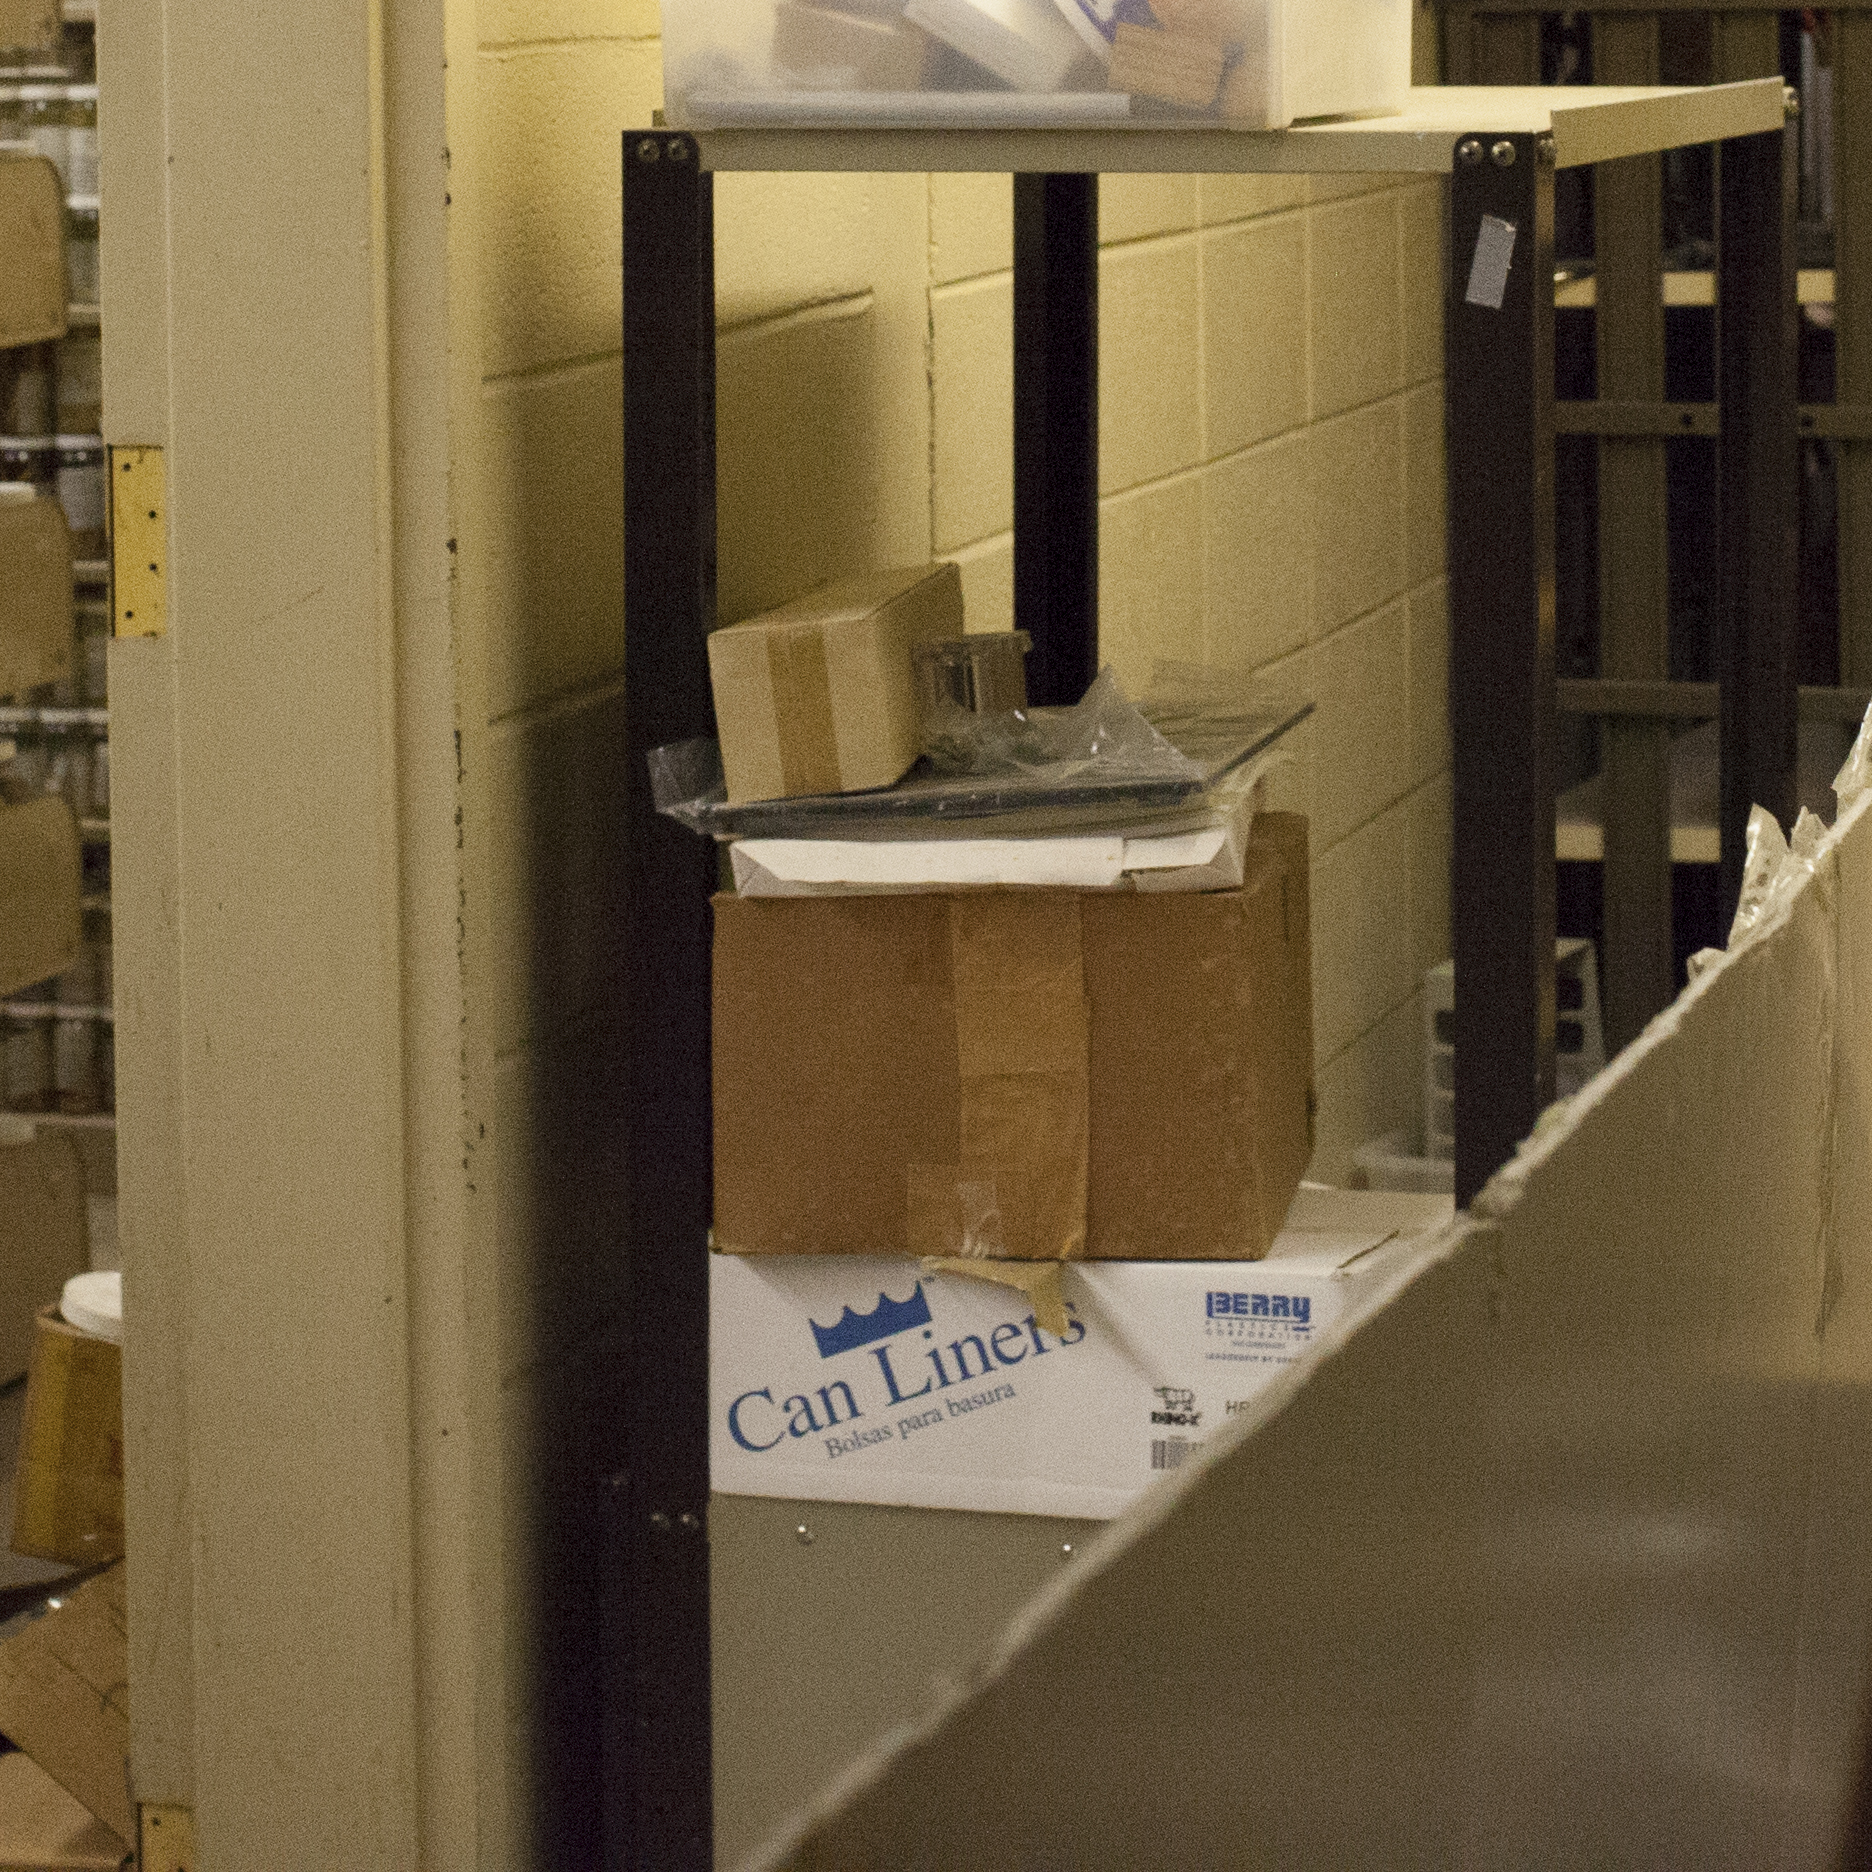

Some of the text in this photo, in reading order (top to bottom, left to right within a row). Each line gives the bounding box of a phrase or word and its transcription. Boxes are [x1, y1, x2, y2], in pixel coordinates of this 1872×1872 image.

[1206, 1291, 1311, 1324] BERRY
[727, 1301, 1087, 1453] Can Liners
[825, 1383, 1017, 1459] Bolsas para basura
